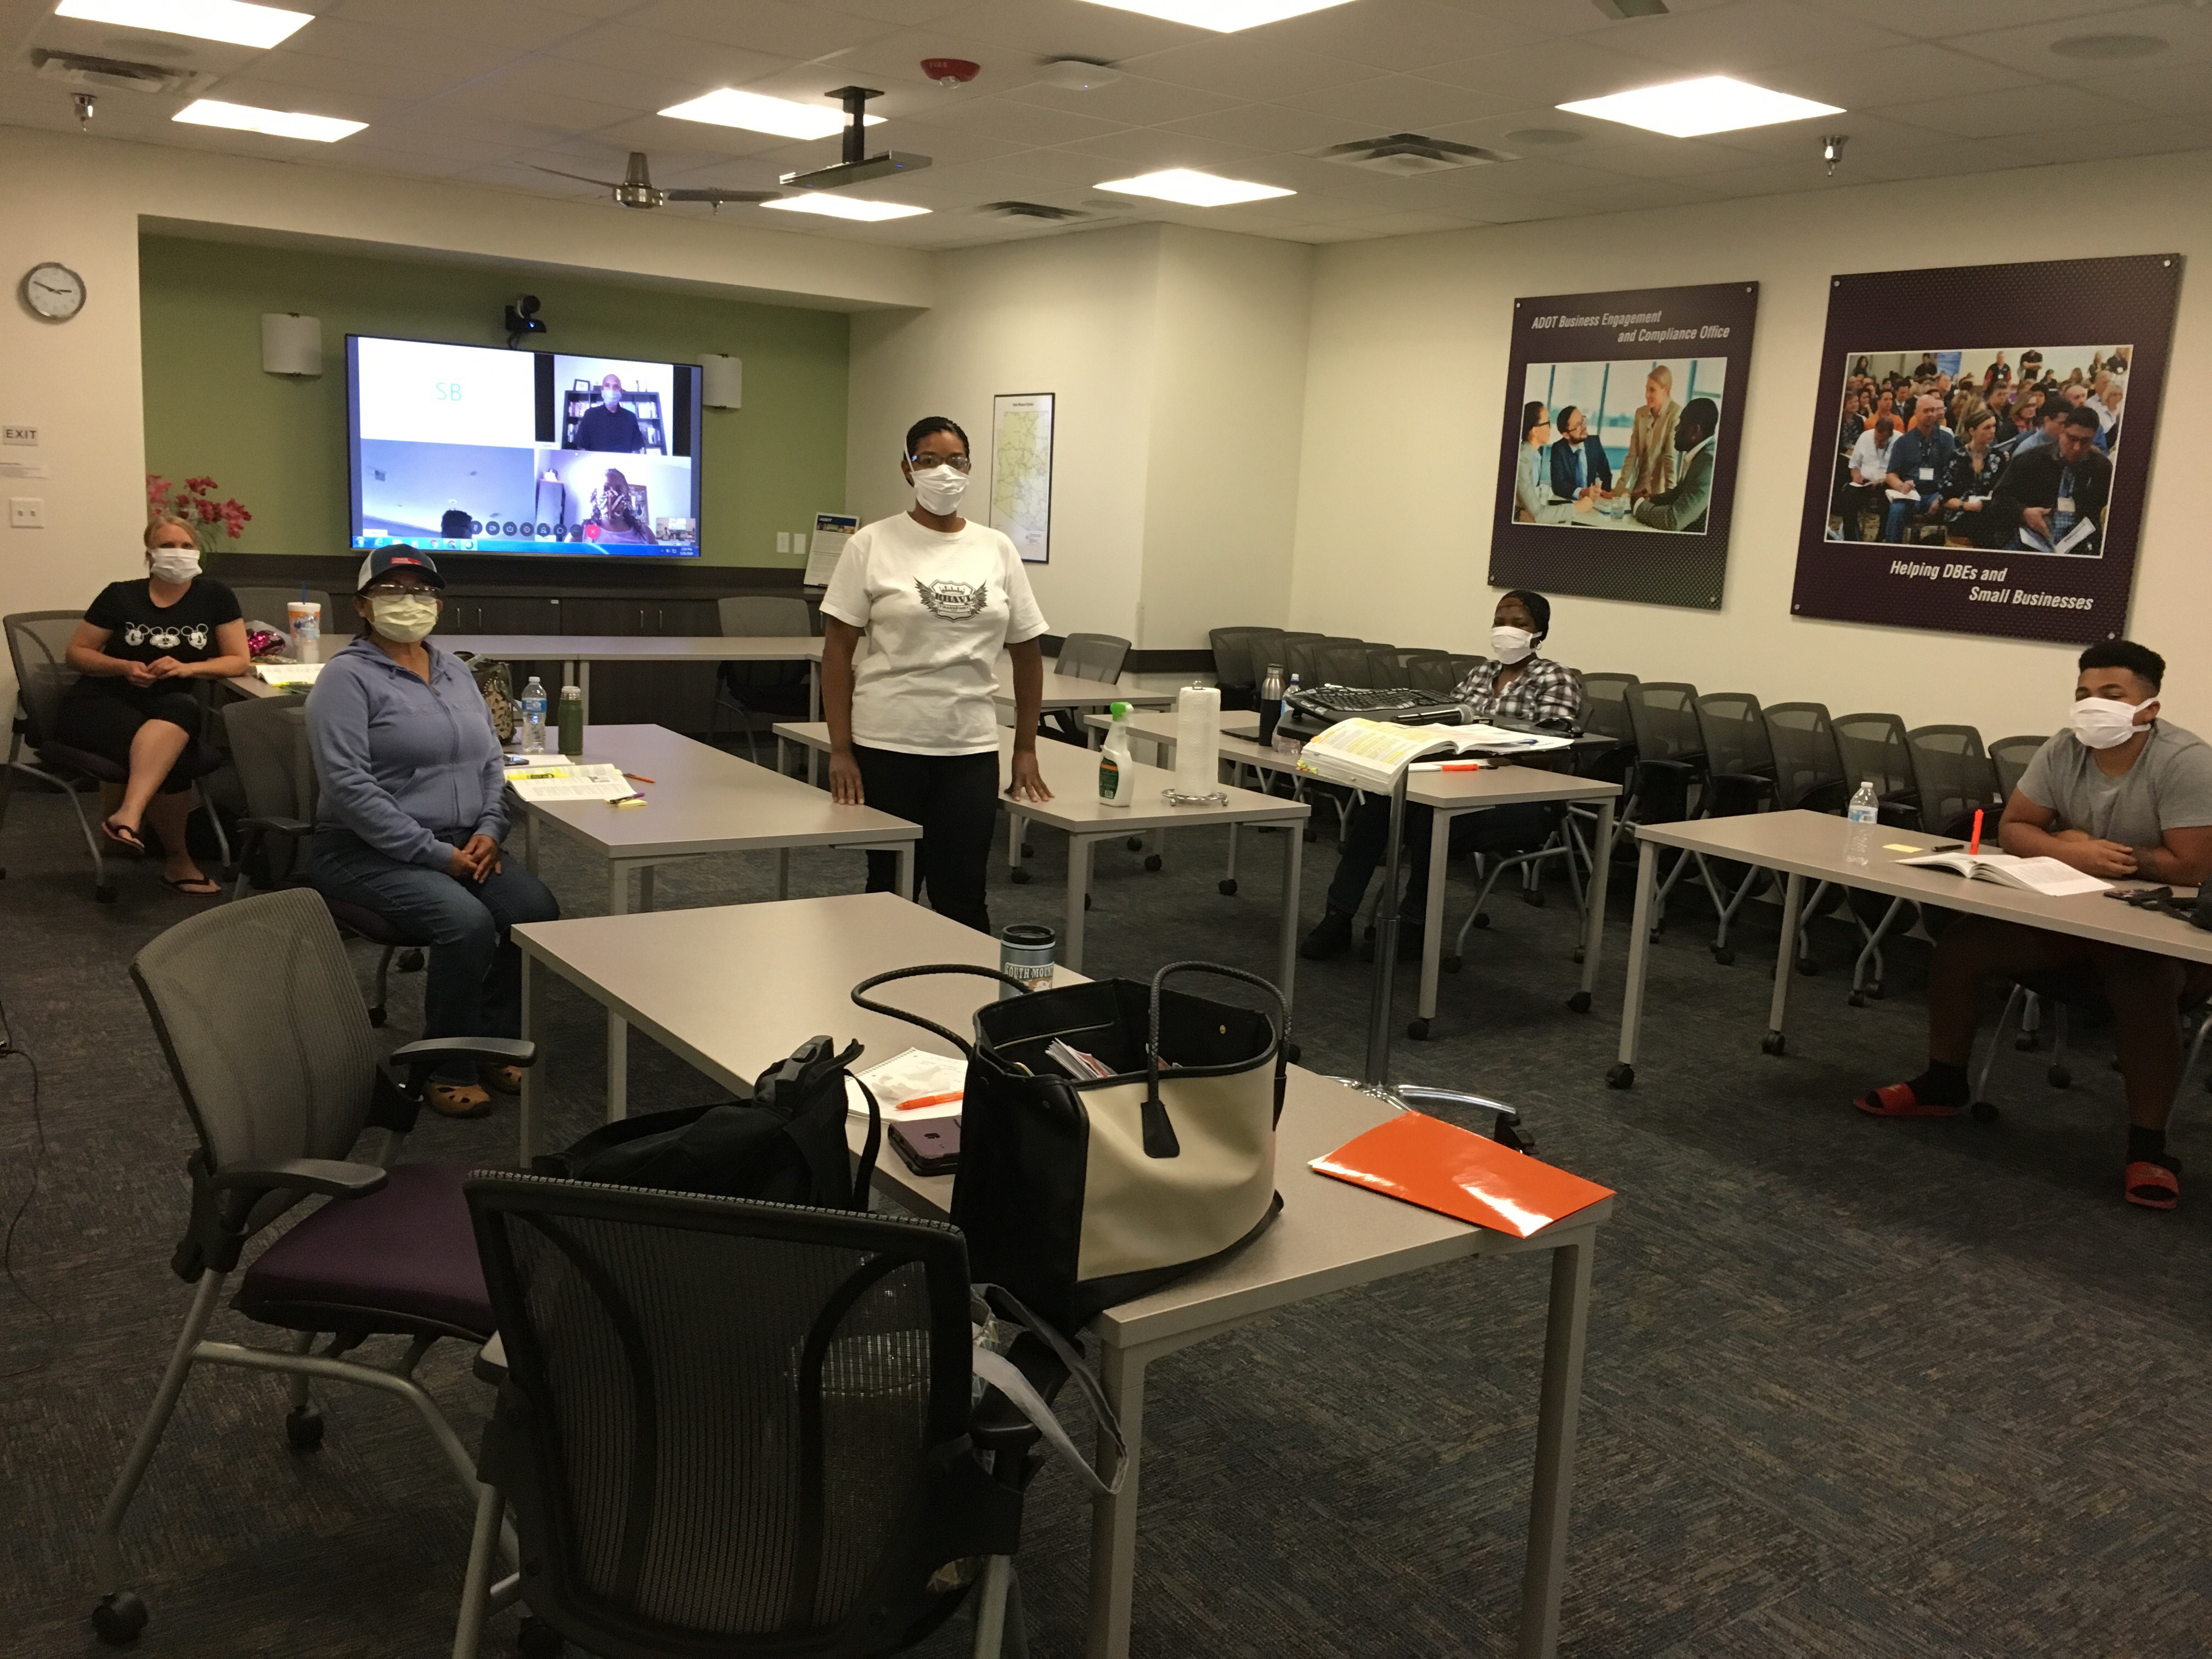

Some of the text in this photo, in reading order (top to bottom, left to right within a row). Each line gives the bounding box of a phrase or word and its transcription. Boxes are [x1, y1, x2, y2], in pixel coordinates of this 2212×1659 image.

[1531, 311, 1662, 329] ADOT Business Engagement
[1618, 325, 1730, 343] and Compliance Office
[436, 382, 462, 401] SB
[5, 428, 37, 439] EXIT
[1889, 560, 2008, 582] Helping DBEs and
[1968, 586, 2094, 610] Small Businesses
[1005, 964, 1030, 979] SOUTH
